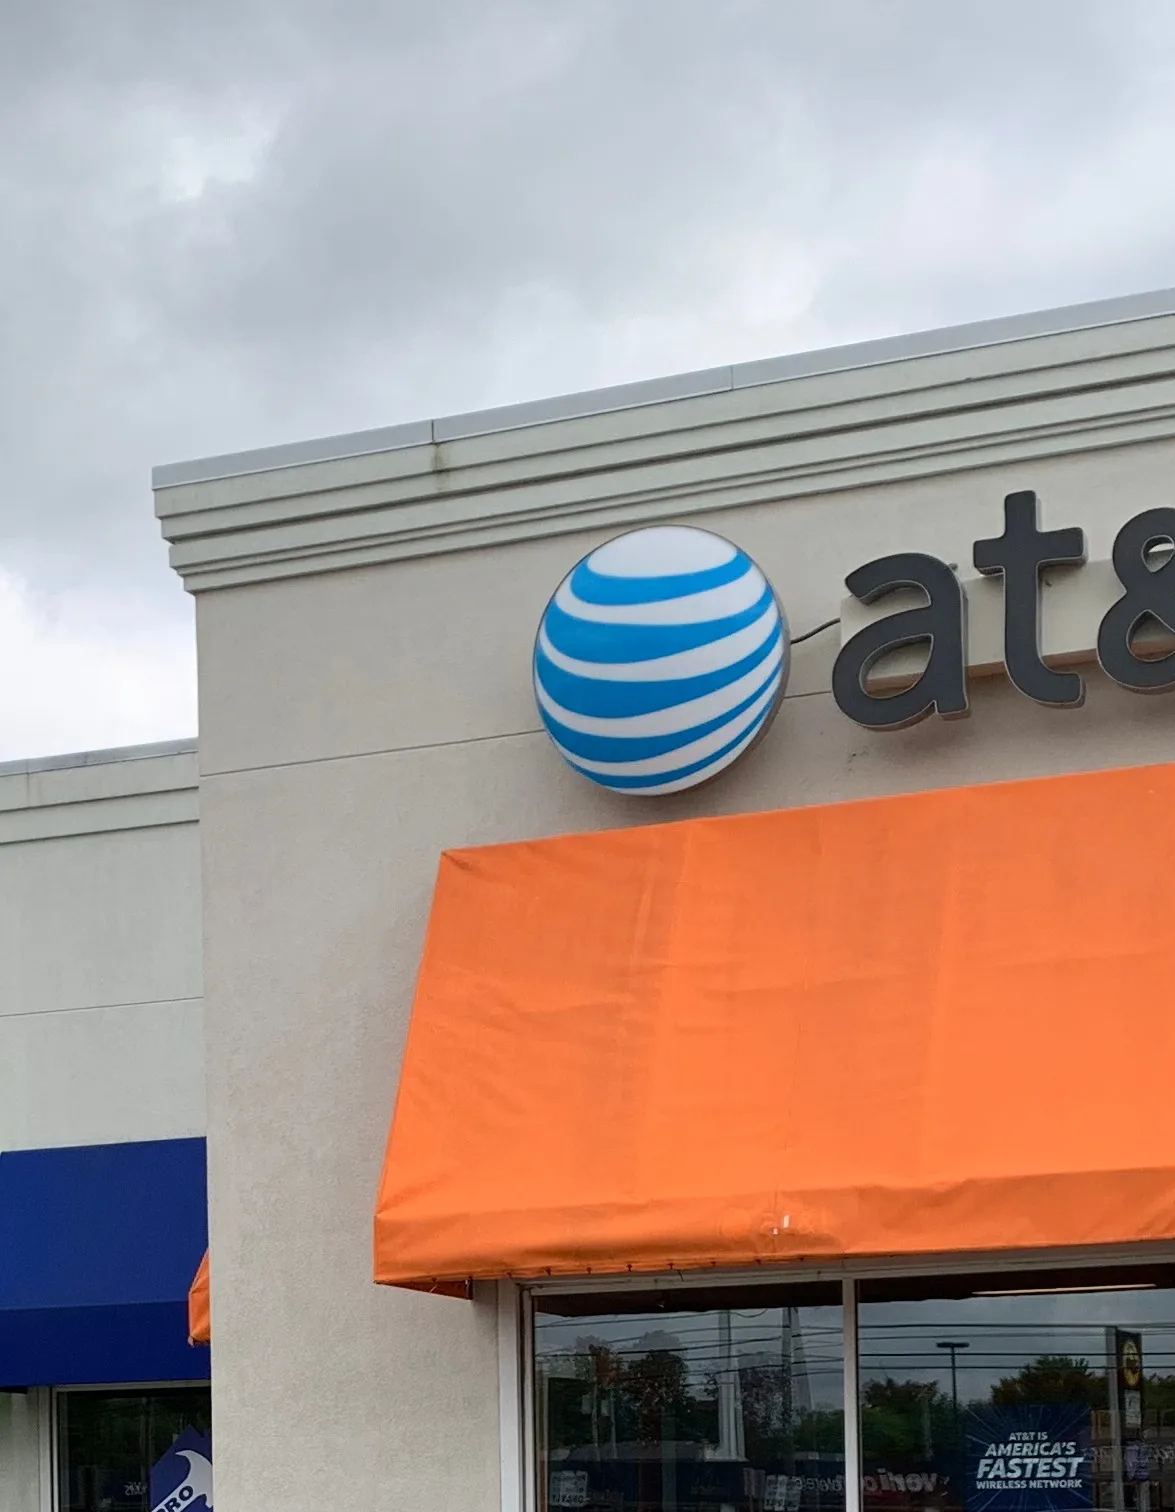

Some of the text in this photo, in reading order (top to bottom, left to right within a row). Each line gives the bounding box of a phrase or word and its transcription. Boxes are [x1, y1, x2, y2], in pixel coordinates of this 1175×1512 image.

[1009, 1432, 1048, 1440] AT&T IS
[985, 1442, 1076, 1456] AMERICA'S
[976, 1457, 1084, 1479] FASTEST
[976, 1479, 1082, 1489] WIRELESS NETWORK
